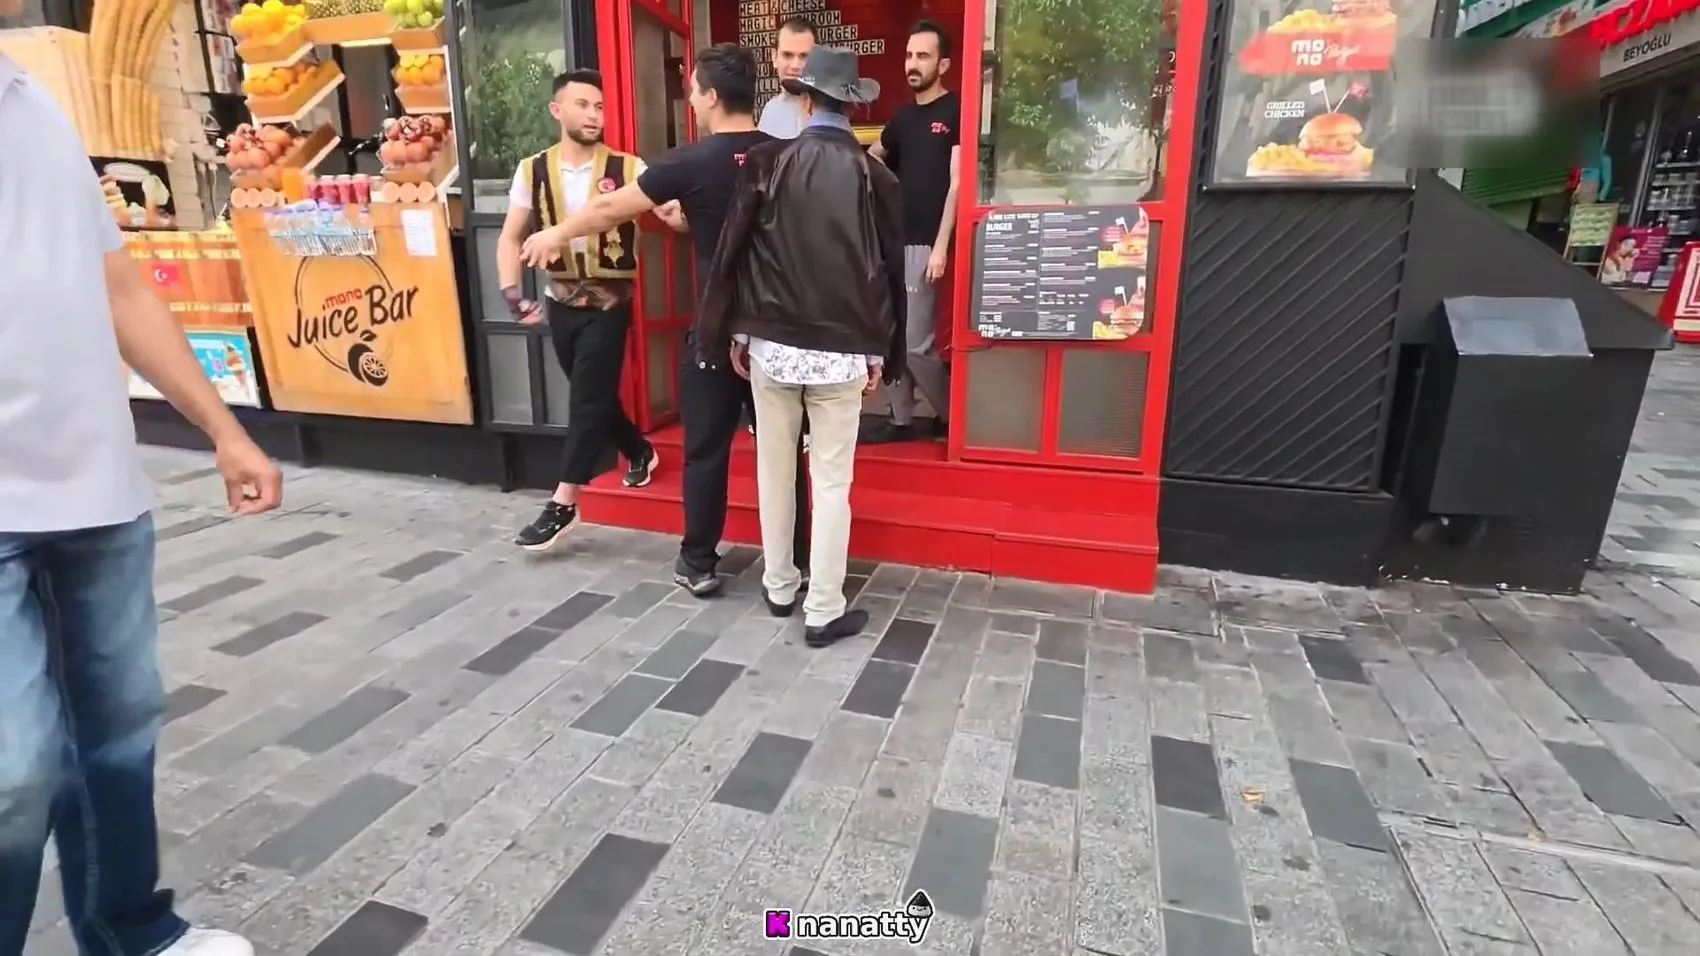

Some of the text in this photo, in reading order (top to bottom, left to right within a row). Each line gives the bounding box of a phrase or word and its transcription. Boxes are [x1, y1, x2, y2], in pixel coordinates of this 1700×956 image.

[739, 2, 768, 17] MEAT
[780, 0, 825, 12] CHEESE
[739, 17, 775, 32] MAGIC
[739, 25, 858, 48] SMOKE URGER
[1266, 101, 1305, 110] GRILLED
[1264, 110, 1305, 119] CHICKEN
[287, 284, 419, 348] Juice Bar
